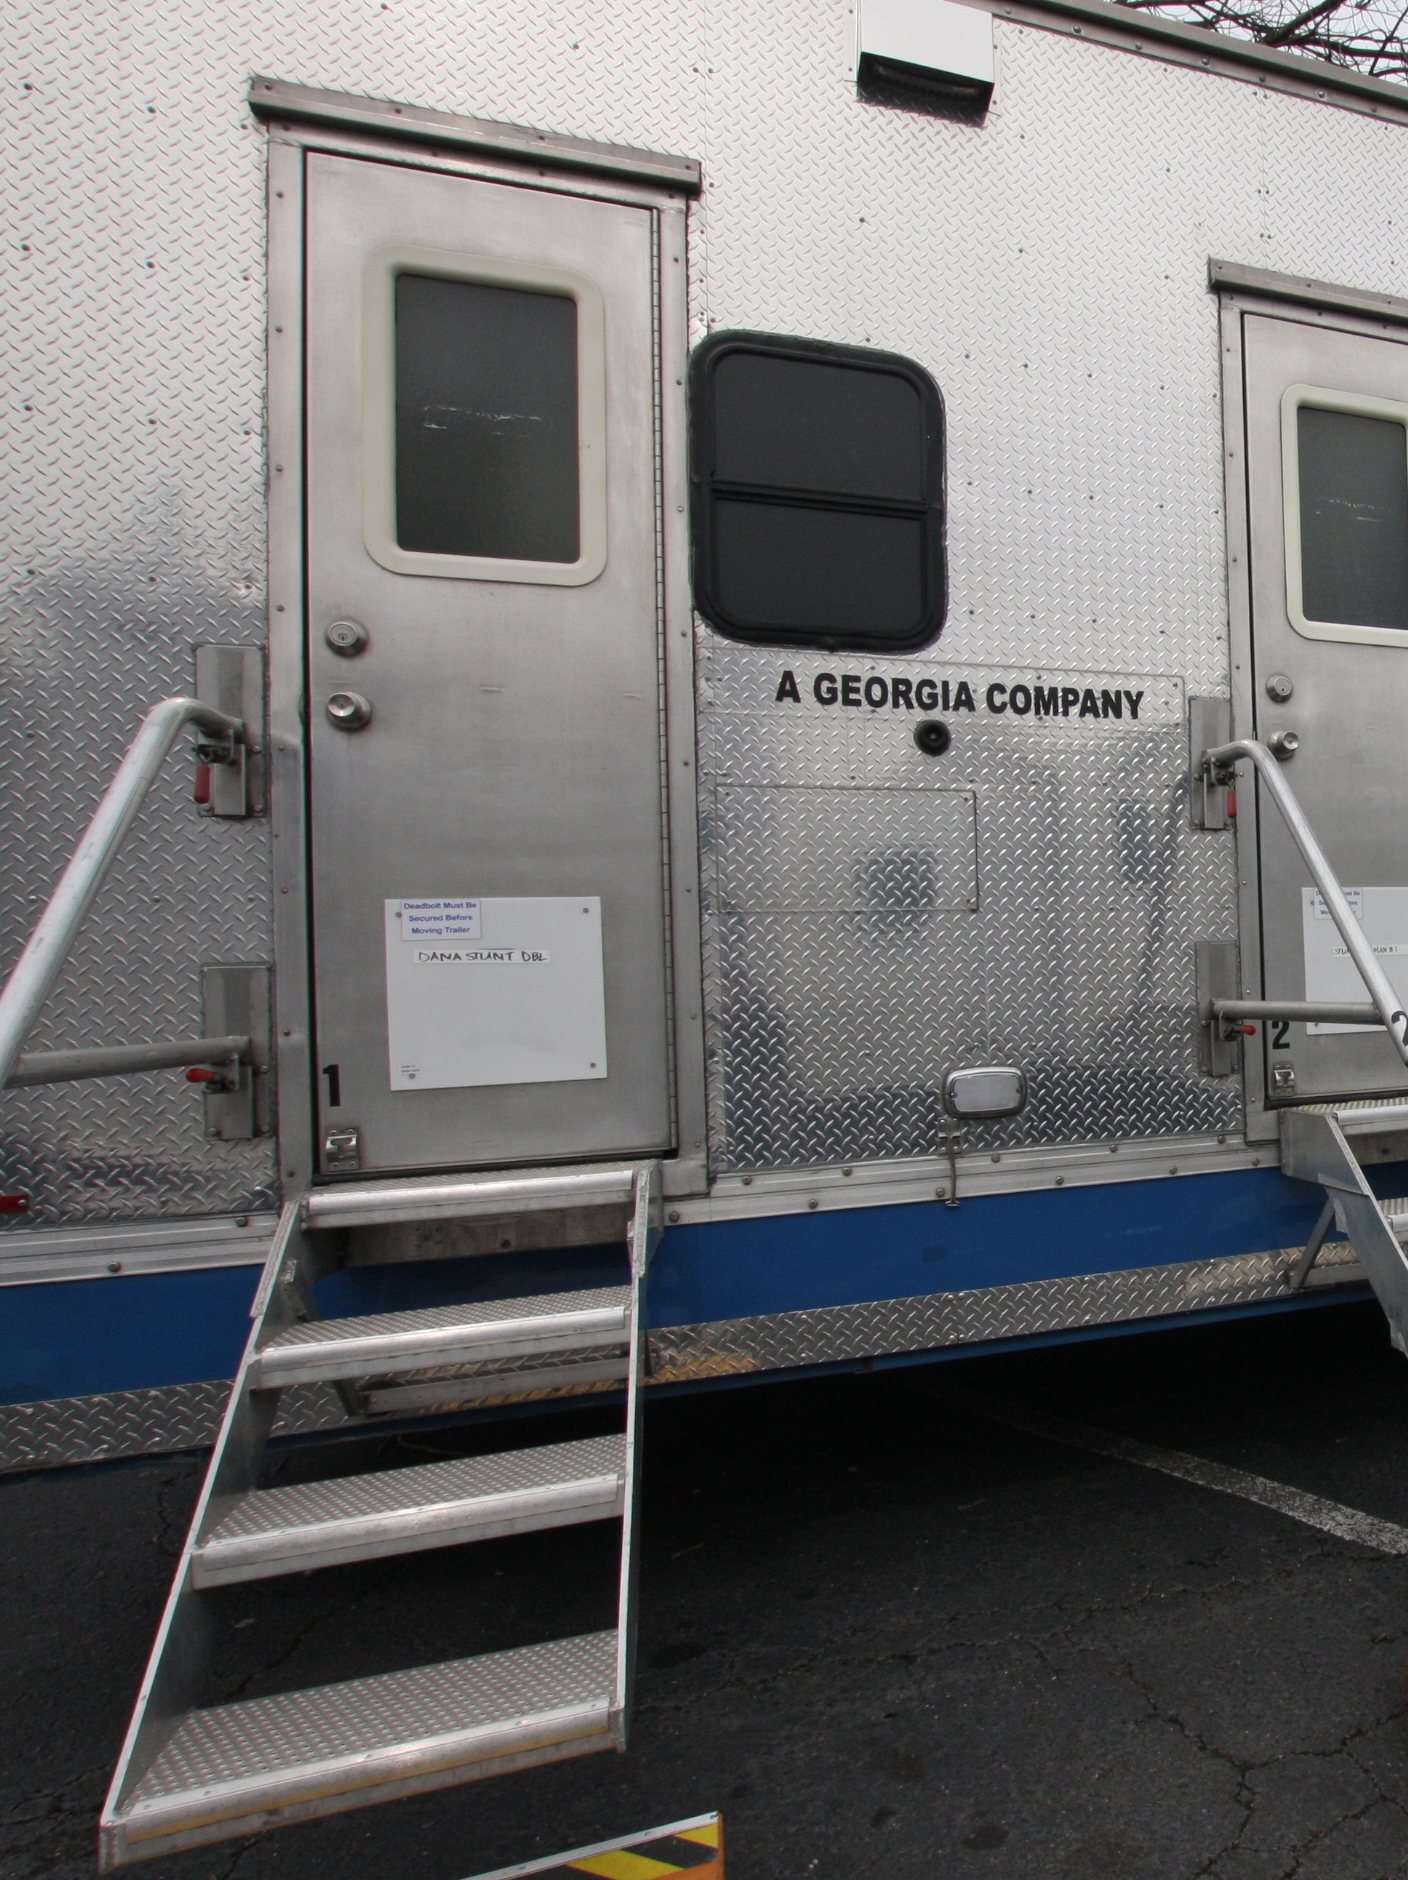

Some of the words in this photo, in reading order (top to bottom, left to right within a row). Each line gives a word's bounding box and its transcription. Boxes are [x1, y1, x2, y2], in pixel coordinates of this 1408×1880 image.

[775, 670, 801, 703] A
[813, 673, 976, 712] GEORGIA
[986, 682, 1145, 719] COMPANY
[411, 927, 442, 935] Moving
[418, 951, 462, 962] DANA
[465, 951, 514, 962] STUNT
[521, 950, 548, 962] DBL
[1271, 1020, 1291, 1050] 2
[322, 1064, 341, 1107] 1
